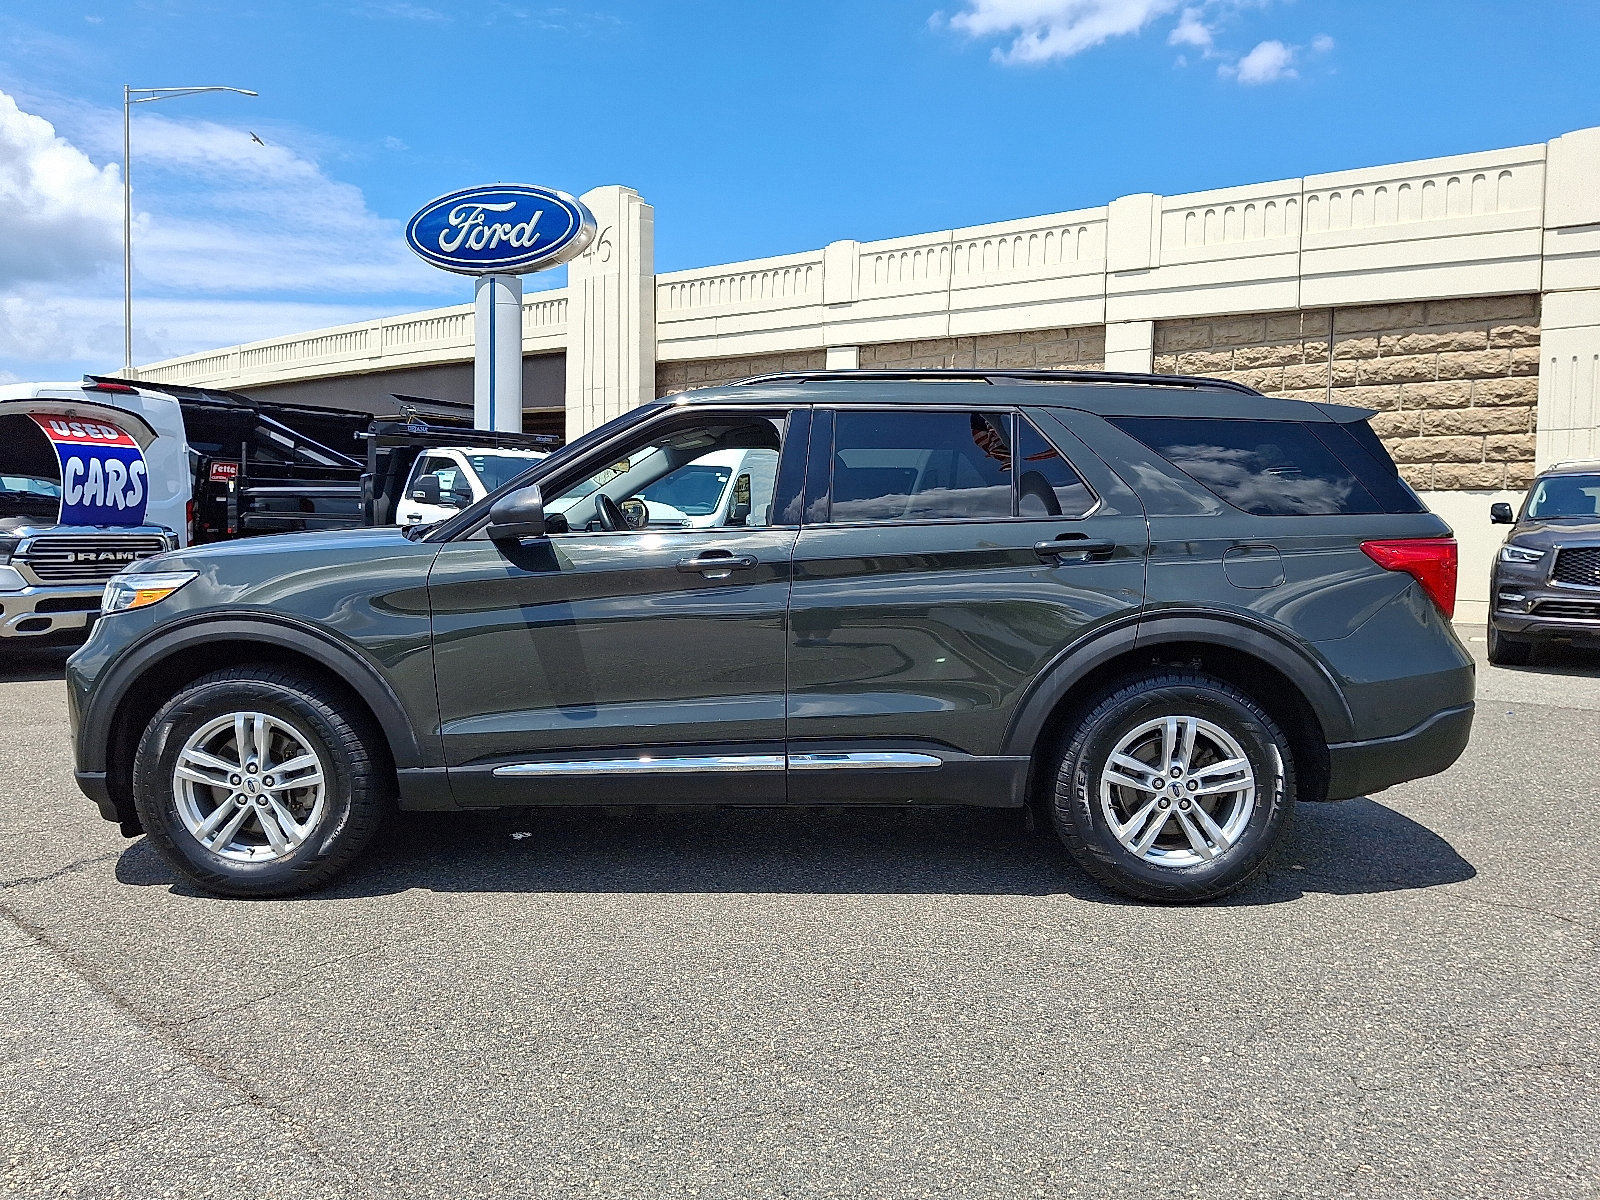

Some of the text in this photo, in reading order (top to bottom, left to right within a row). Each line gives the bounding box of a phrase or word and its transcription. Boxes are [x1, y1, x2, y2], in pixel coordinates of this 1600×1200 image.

[438, 201, 544, 252] Ford
[49, 420, 119, 440] USED
[64, 456, 146, 511] CARS
[77, 551, 134, 561] RAM
